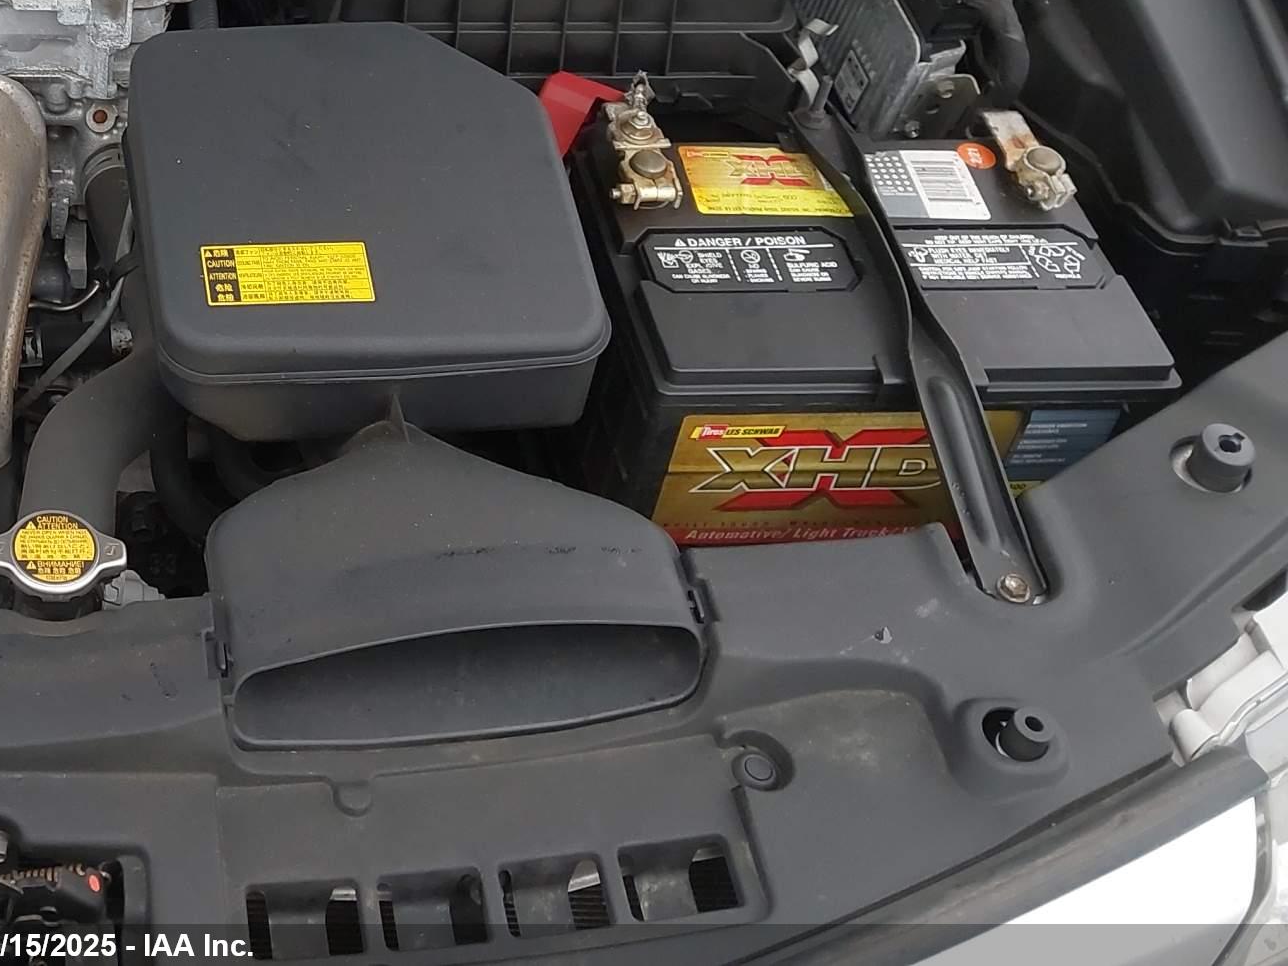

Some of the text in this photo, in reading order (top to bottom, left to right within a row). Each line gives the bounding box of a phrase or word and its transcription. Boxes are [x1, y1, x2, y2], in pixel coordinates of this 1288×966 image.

[687, 236, 807, 247] DANGER / POISON
[207, 259, 235, 268] CAUTION
[209, 272, 237, 280] ATTENTION
[726, 428, 742, 436] LES
[742, 427, 780, 435] SCHWAB
[688, 444, 942, 493] XHD
[36, 515, 69, 523] CAUTION
[37, 522, 79, 530] ATTENTION
[686, 528, 793, 541] Automotive/
[792, 527, 837, 541] Light
[37, 561, 85, 569] ВНИМАНИЕ!
